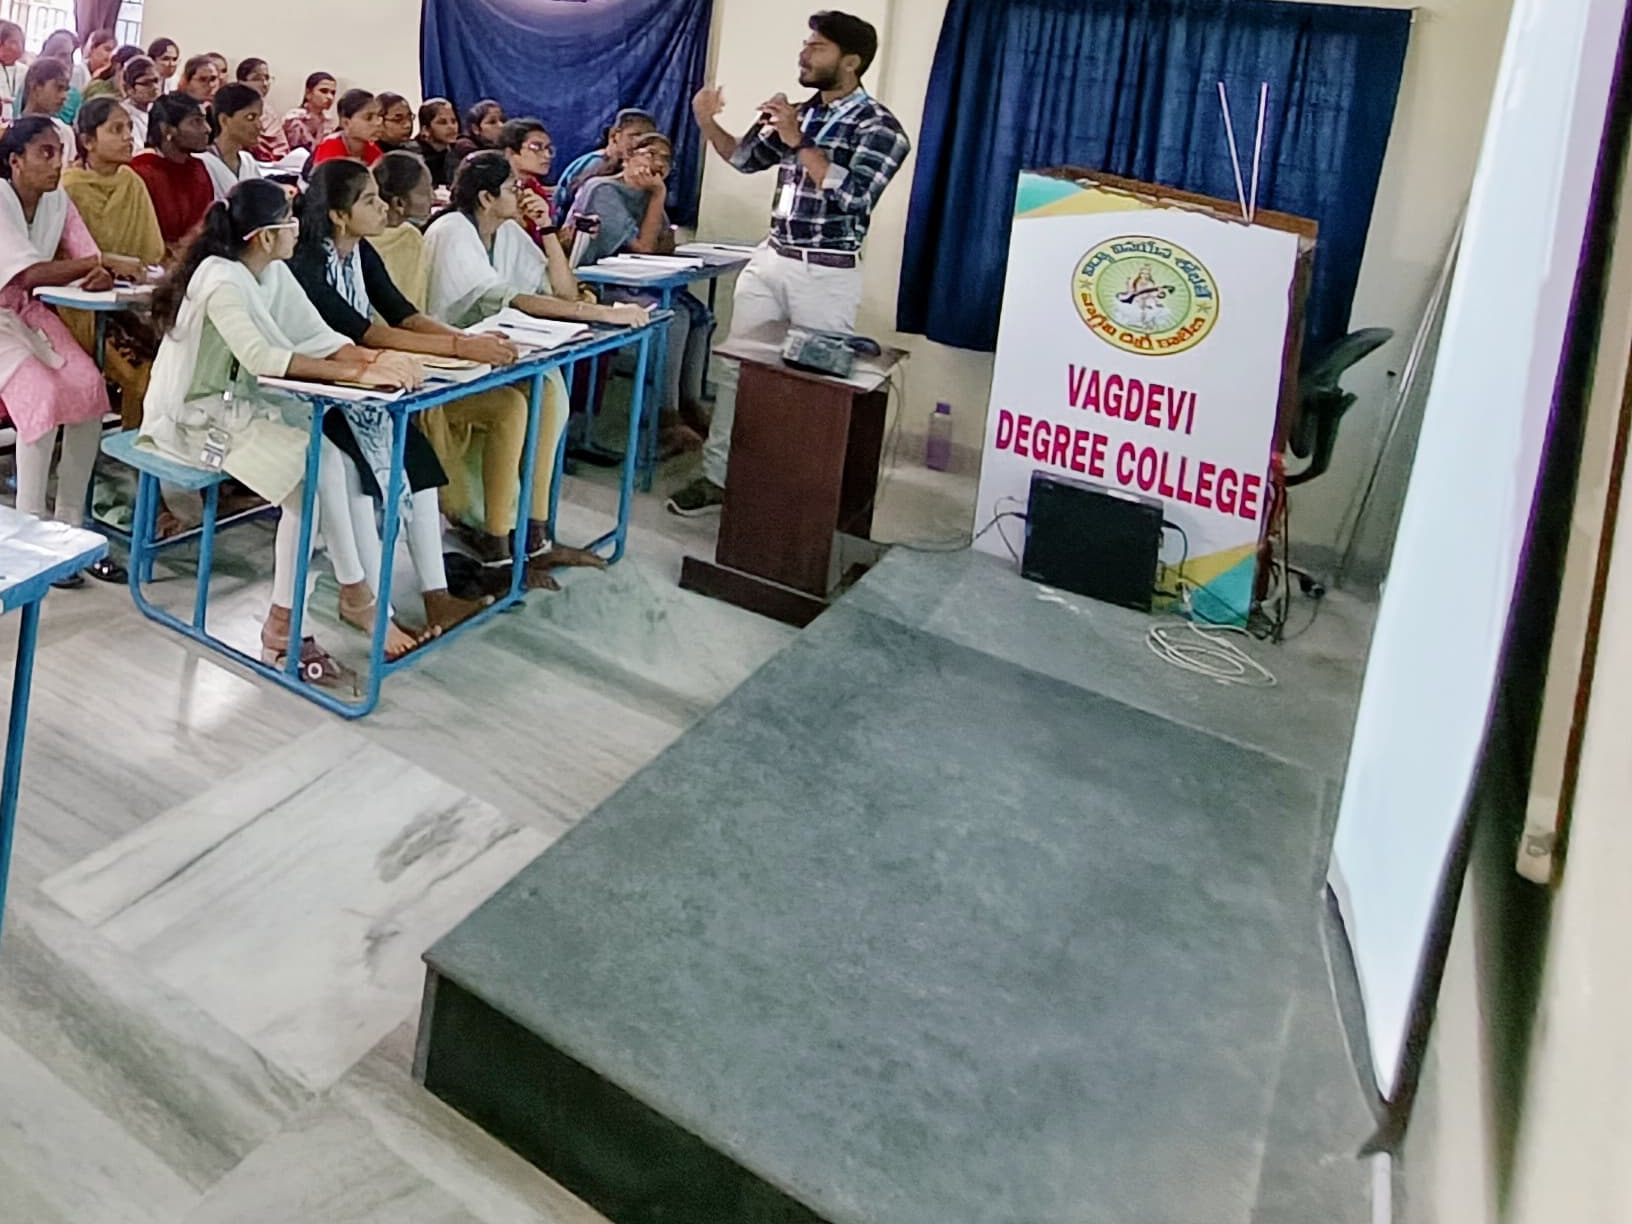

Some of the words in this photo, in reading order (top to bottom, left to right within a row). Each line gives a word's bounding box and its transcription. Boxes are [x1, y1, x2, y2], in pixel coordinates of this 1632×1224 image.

[1068, 364, 1197, 435] VAGDEVI
[995, 409, 1108, 478] DEGREE
[1116, 441, 1262, 520] COLLEGE
